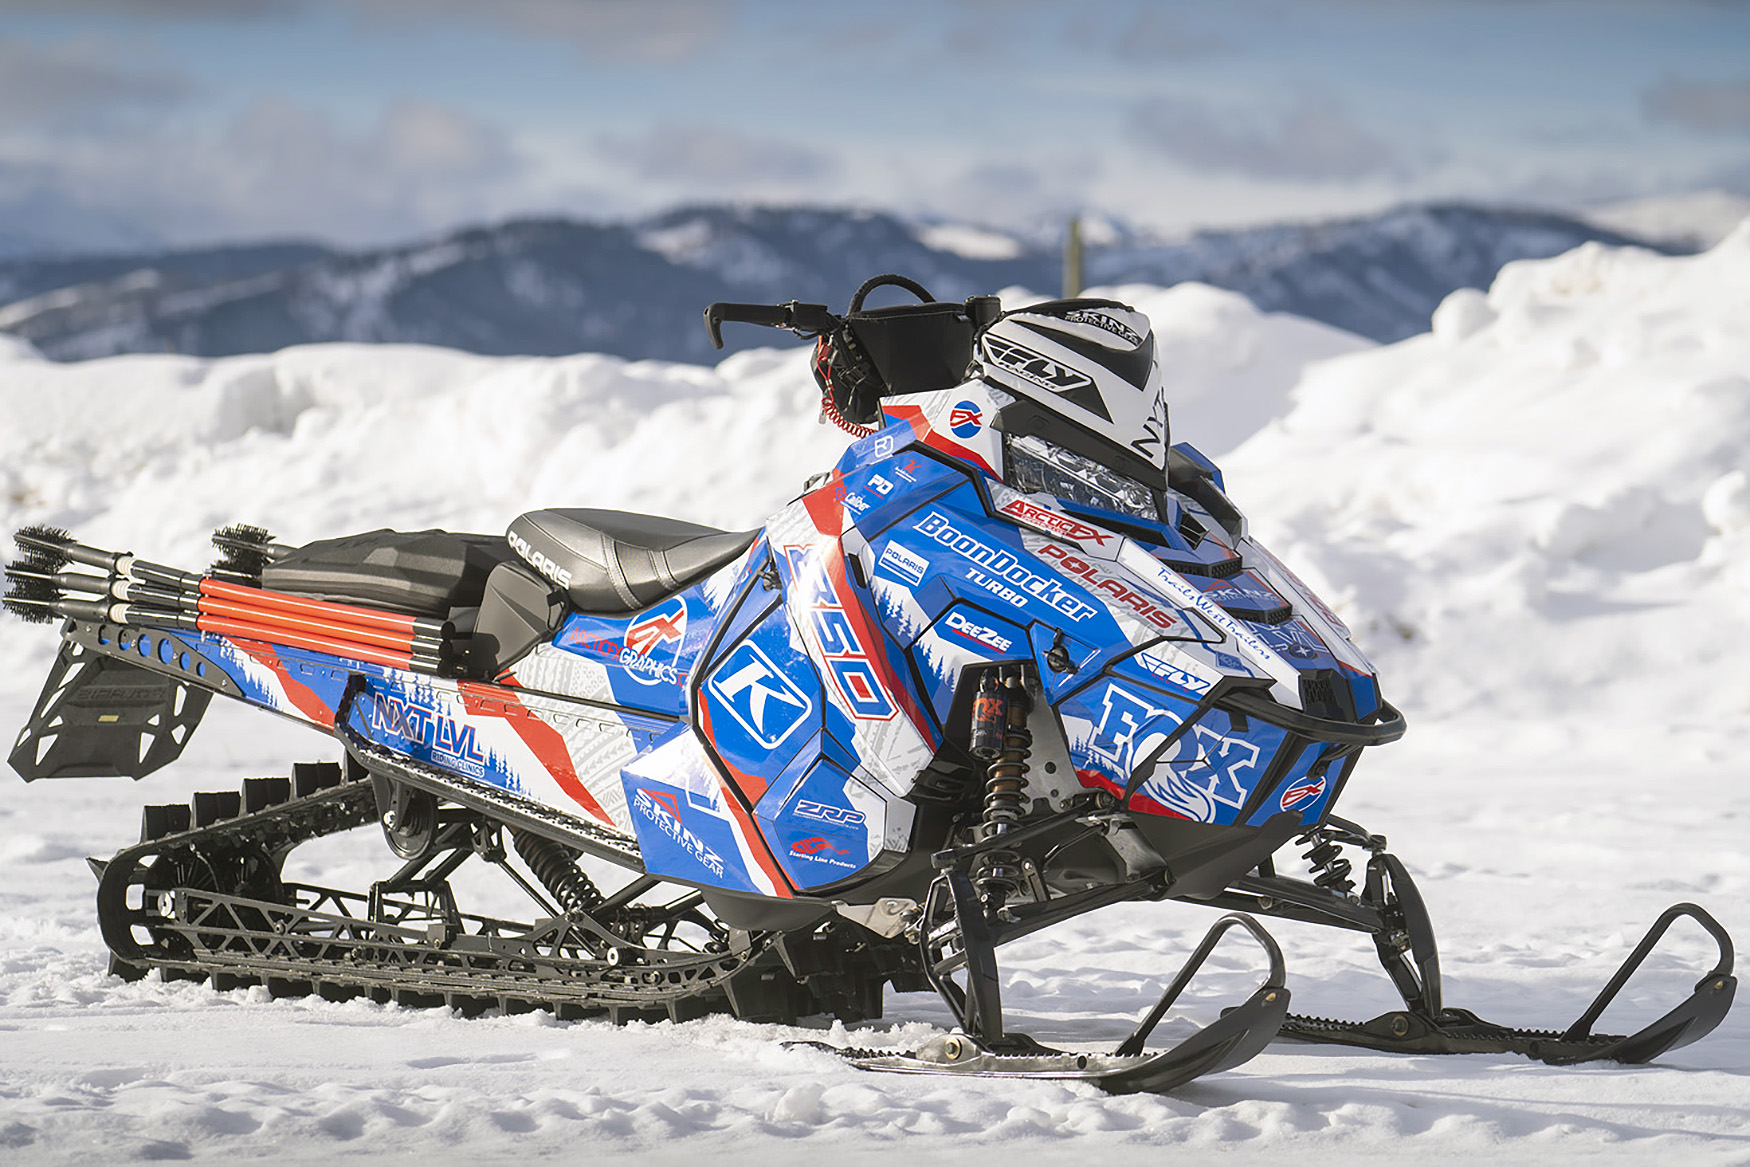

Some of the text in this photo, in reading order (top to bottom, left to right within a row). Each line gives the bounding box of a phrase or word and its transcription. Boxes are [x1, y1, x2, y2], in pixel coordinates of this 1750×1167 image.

[997, 345, 1089, 386] FLY
[950, 409, 983, 427] FX
[508, 530, 572, 590] POLARIS
[885, 547, 925, 576] POLARIS
[964, 566, 1029, 609] TURBO
[1037, 543, 1177, 629] POLARIS
[1148, 658, 1210, 691] FLY
[372, 691, 486, 767] NXT LVL
[431, 750, 485, 779] RIDING CLINICS
[634, 787, 725, 871] SKINZ
[794, 799, 867, 824] ZRP
[633, 797, 724, 879] PROTECTIVE GEAR
[788, 850, 857, 869] Starting Line Products
